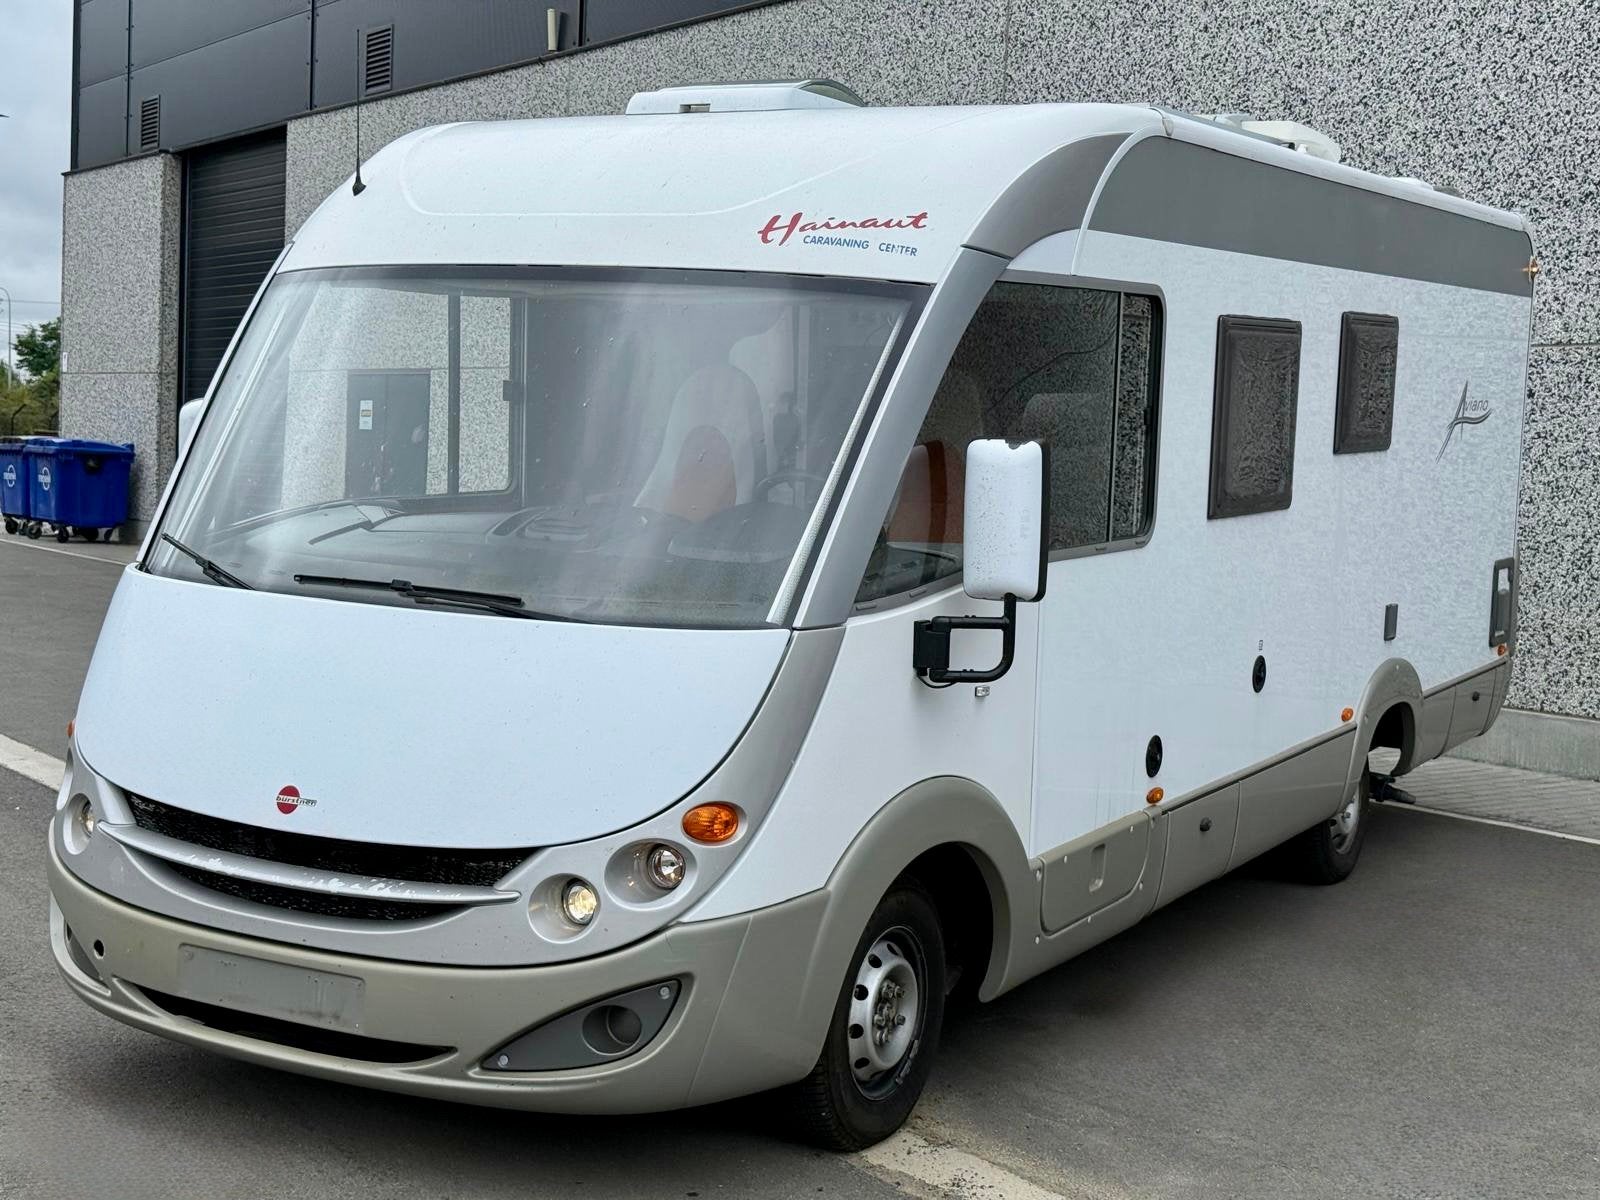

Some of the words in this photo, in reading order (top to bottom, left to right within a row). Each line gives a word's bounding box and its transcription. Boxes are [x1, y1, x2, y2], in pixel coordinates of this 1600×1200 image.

[757, 212, 928, 247] Hainaut
[803, 235, 869, 250] CARAVANING
[878, 242, 918, 257] CENTER
